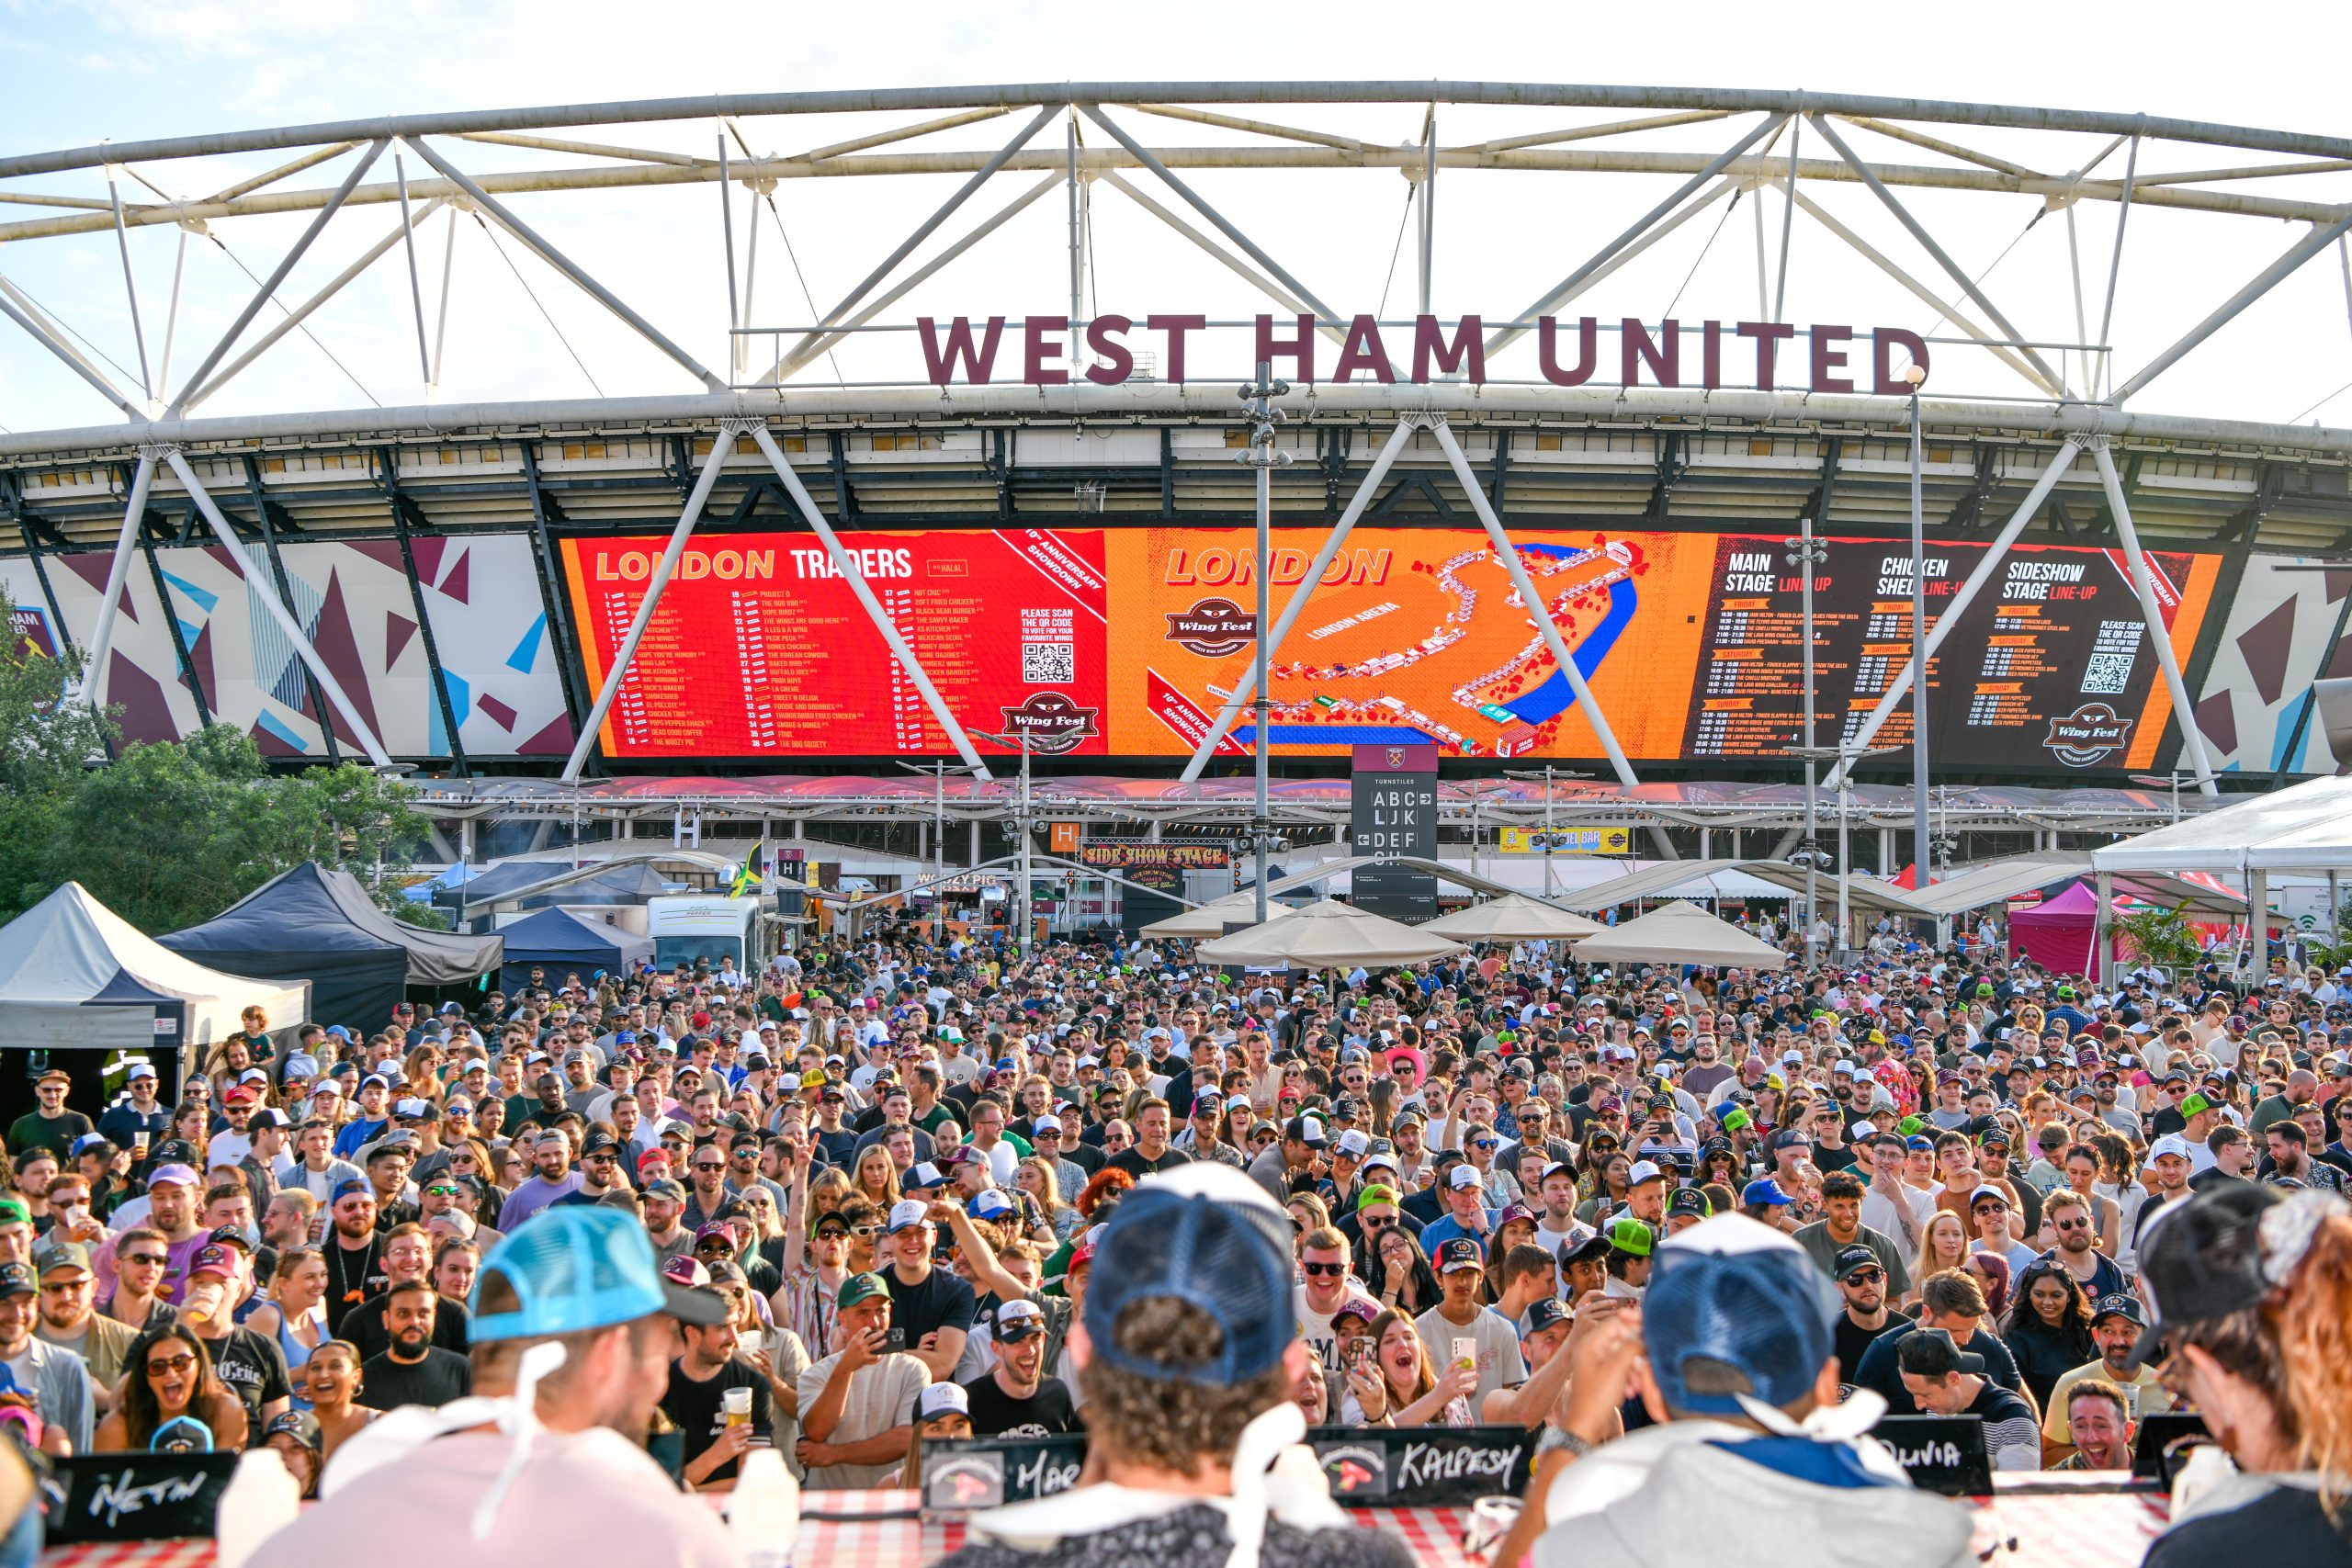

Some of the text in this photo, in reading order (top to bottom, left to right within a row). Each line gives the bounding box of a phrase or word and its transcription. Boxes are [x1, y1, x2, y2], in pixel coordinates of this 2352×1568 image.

[916, 314, 1930, 396] WEST HAM UNITED
[596, 548, 913, 582] LONDON TRADERS
[941, 564, 963, 572] HALAL
[1027, 545, 1082, 590] SHOWDOWN
[1040, 539, 1102, 591] ANNIVERSARY
[1164, 547, 1392, 586] LONDON
[1728, 553, 1771, 572] MAIN
[1882, 557, 1949, 577] CHICKEN
[2007, 562, 2085, 581] SIDESHOW
[1724, 574, 1775, 592] STAGE
[1876, 578, 1914, 596] SHED
[2003, 581, 2098, 600] STAGE LINE-UP
[1022, 609, 1073, 617] PLEASE SCAN
[1022, 618, 1072, 627] THE QR CODE
[1178, 621, 1252, 632] Wing Fest
[1306, 602, 1401, 640] LONDON ARENA
[2100, 621, 2145, 630] PLEASE SCAN
[2113, 630, 2123, 638] QR
[2124, 631, 2143, 639] CODE
[1014, 716, 1086, 727] Wing Fest
[1174, 702, 1232, 752] ANNIVERRY
[2058, 727, 2119, 739] Wing Fest
[1516, 743, 1534, 754] STAGE
[1518, 738, 1533, 748] MAIN
[1374, 792, 1415, 807] A B C
[1374, 810, 1415, 825] L J K
[674, 803, 701, 849] H
[1058, 826, 1071, 841] H
[1374, 833, 1414, 848] D E F
[1581, 831, 1600, 843] BAR
[1087, 846, 1222, 864] SIDE SHOW STAGE
[784, 863, 792, 874] H
[972, 874, 996, 886] PIG
[1271, 976, 1287, 987] THE
